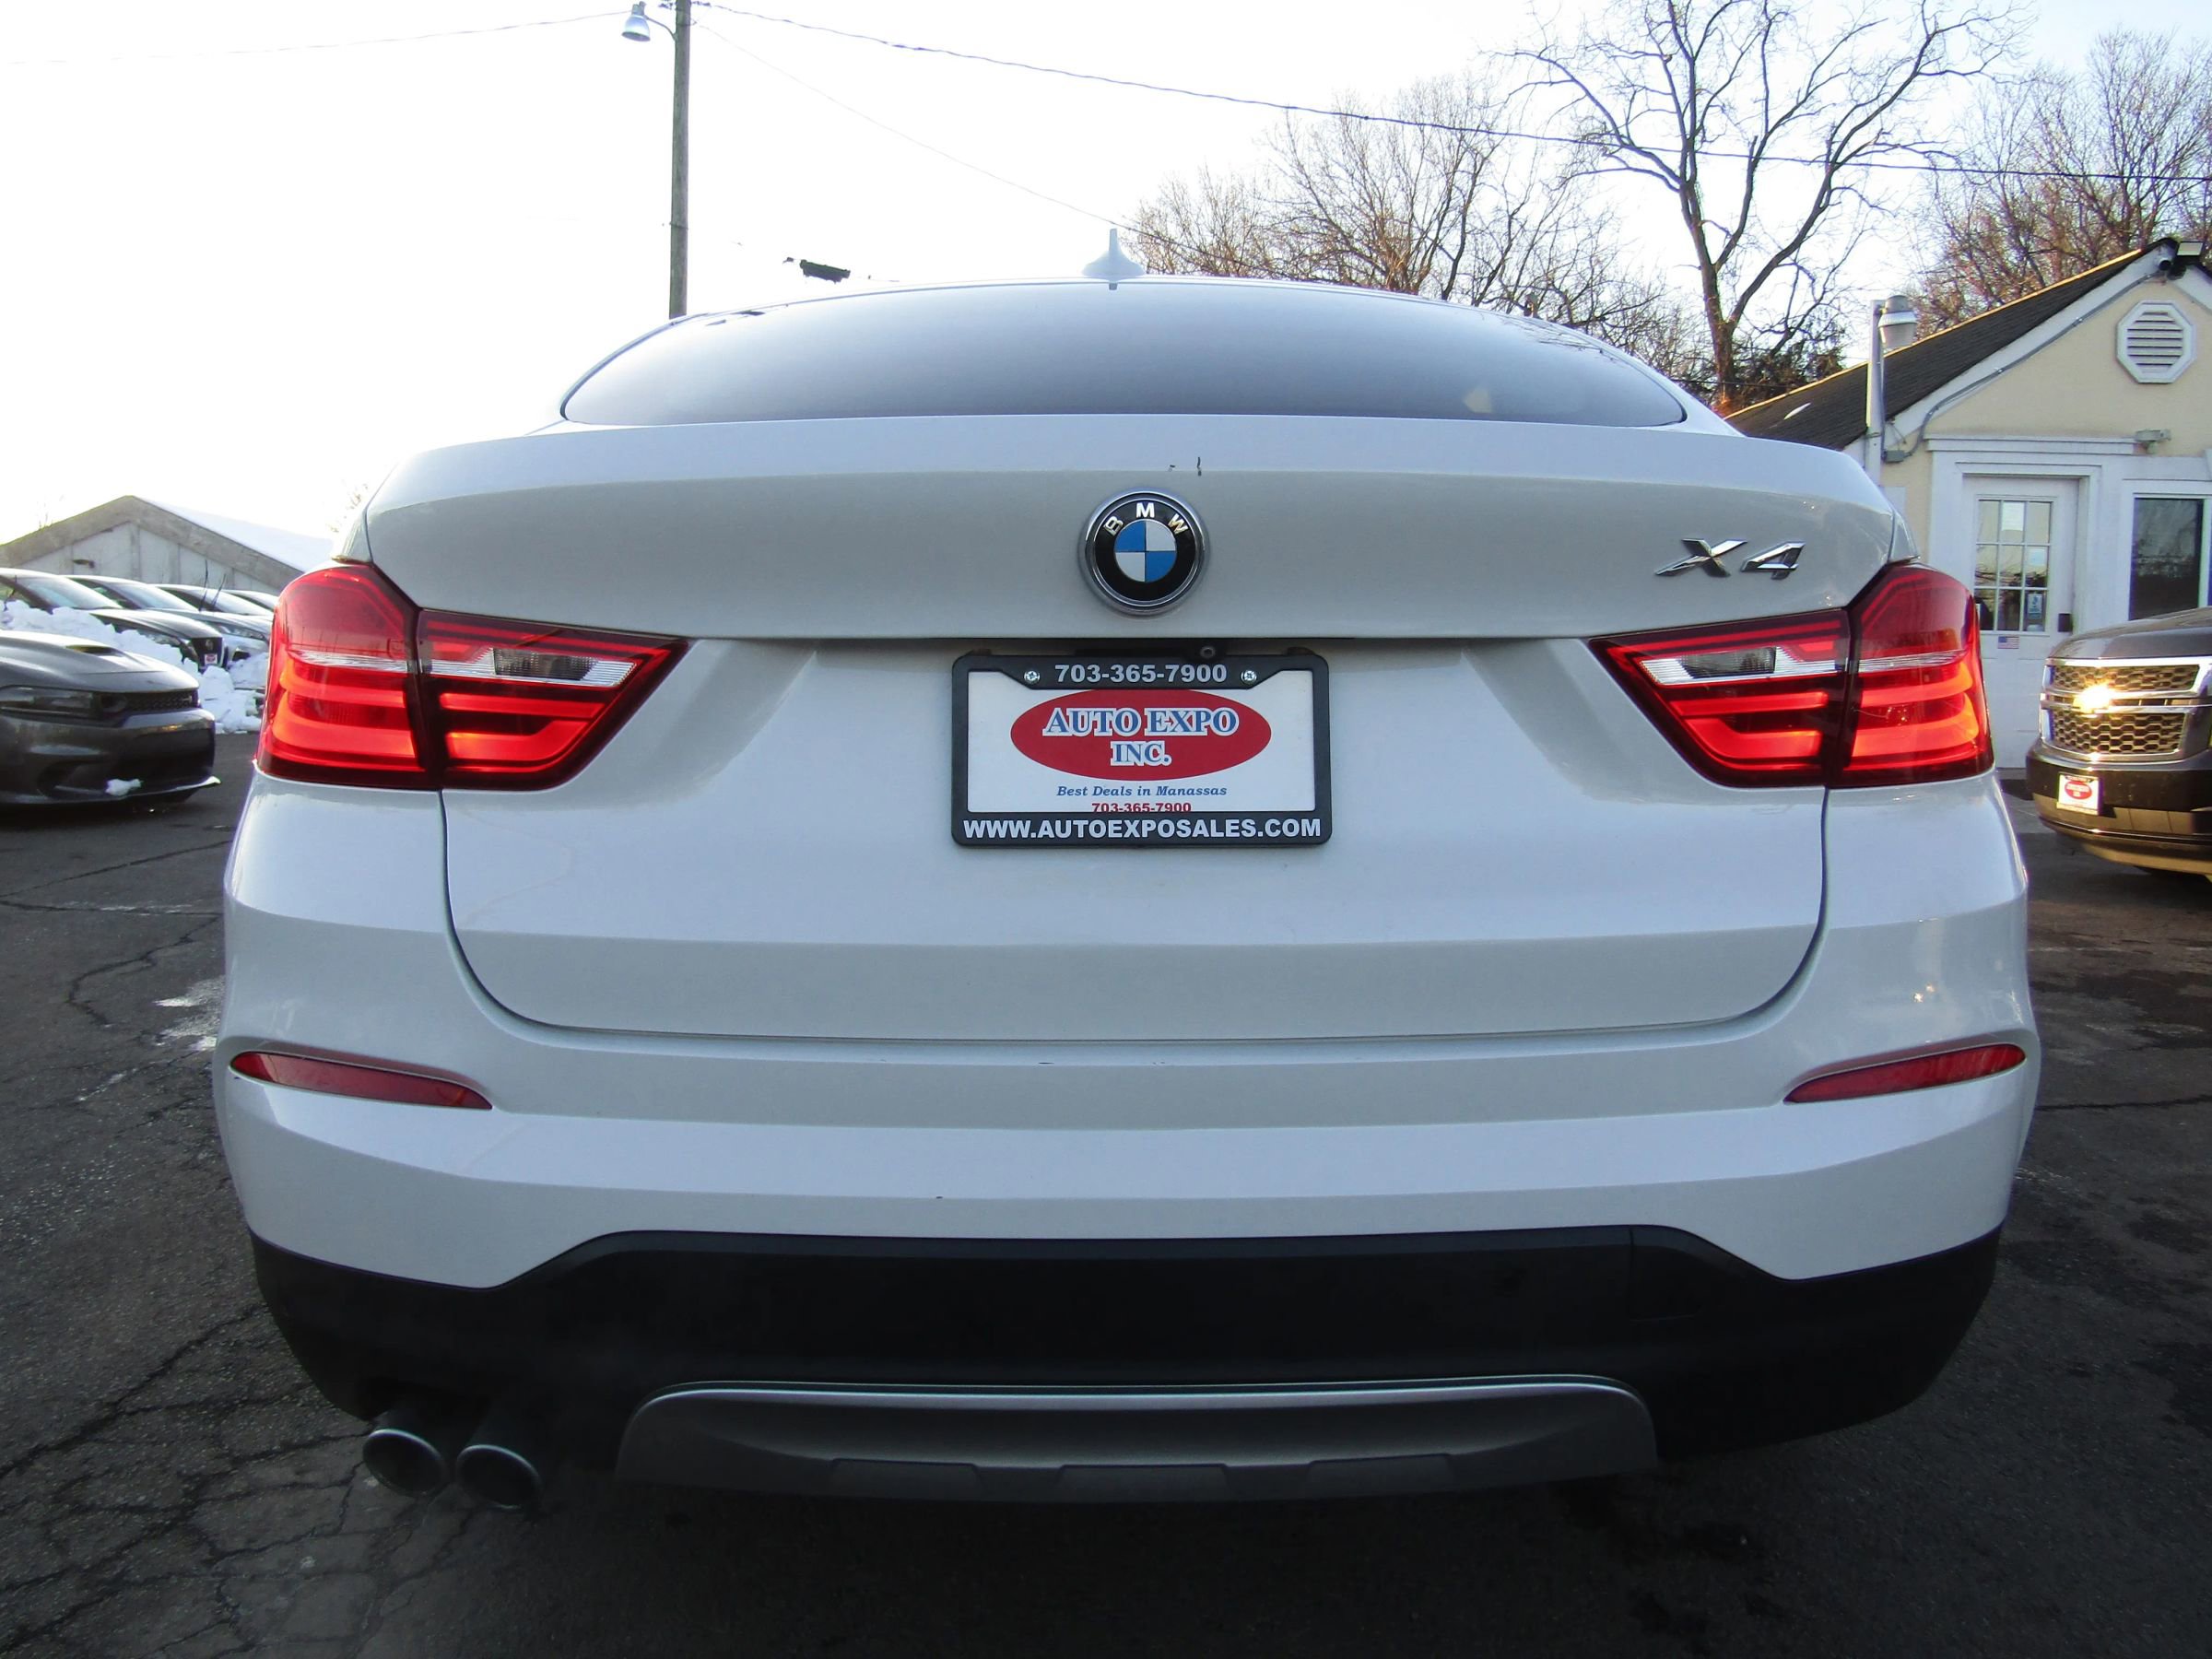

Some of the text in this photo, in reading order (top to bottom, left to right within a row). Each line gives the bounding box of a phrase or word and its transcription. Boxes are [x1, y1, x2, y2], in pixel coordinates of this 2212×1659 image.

[1103, 502, 1188, 536] BMW
[1654, 538, 1806, 580] X4
[1054, 664, 1228, 684] 703-365-7900
[1042, 707, 1240, 736] AUTO EXPO
[1110, 740, 1172, 767] INC.
[1056, 785, 1228, 796] Best Deals in Manassas
[1091, 802, 1192, 812] 703-365-7900
[963, 818, 1321, 839] WWW.AUTOEXPOSALES.COM
